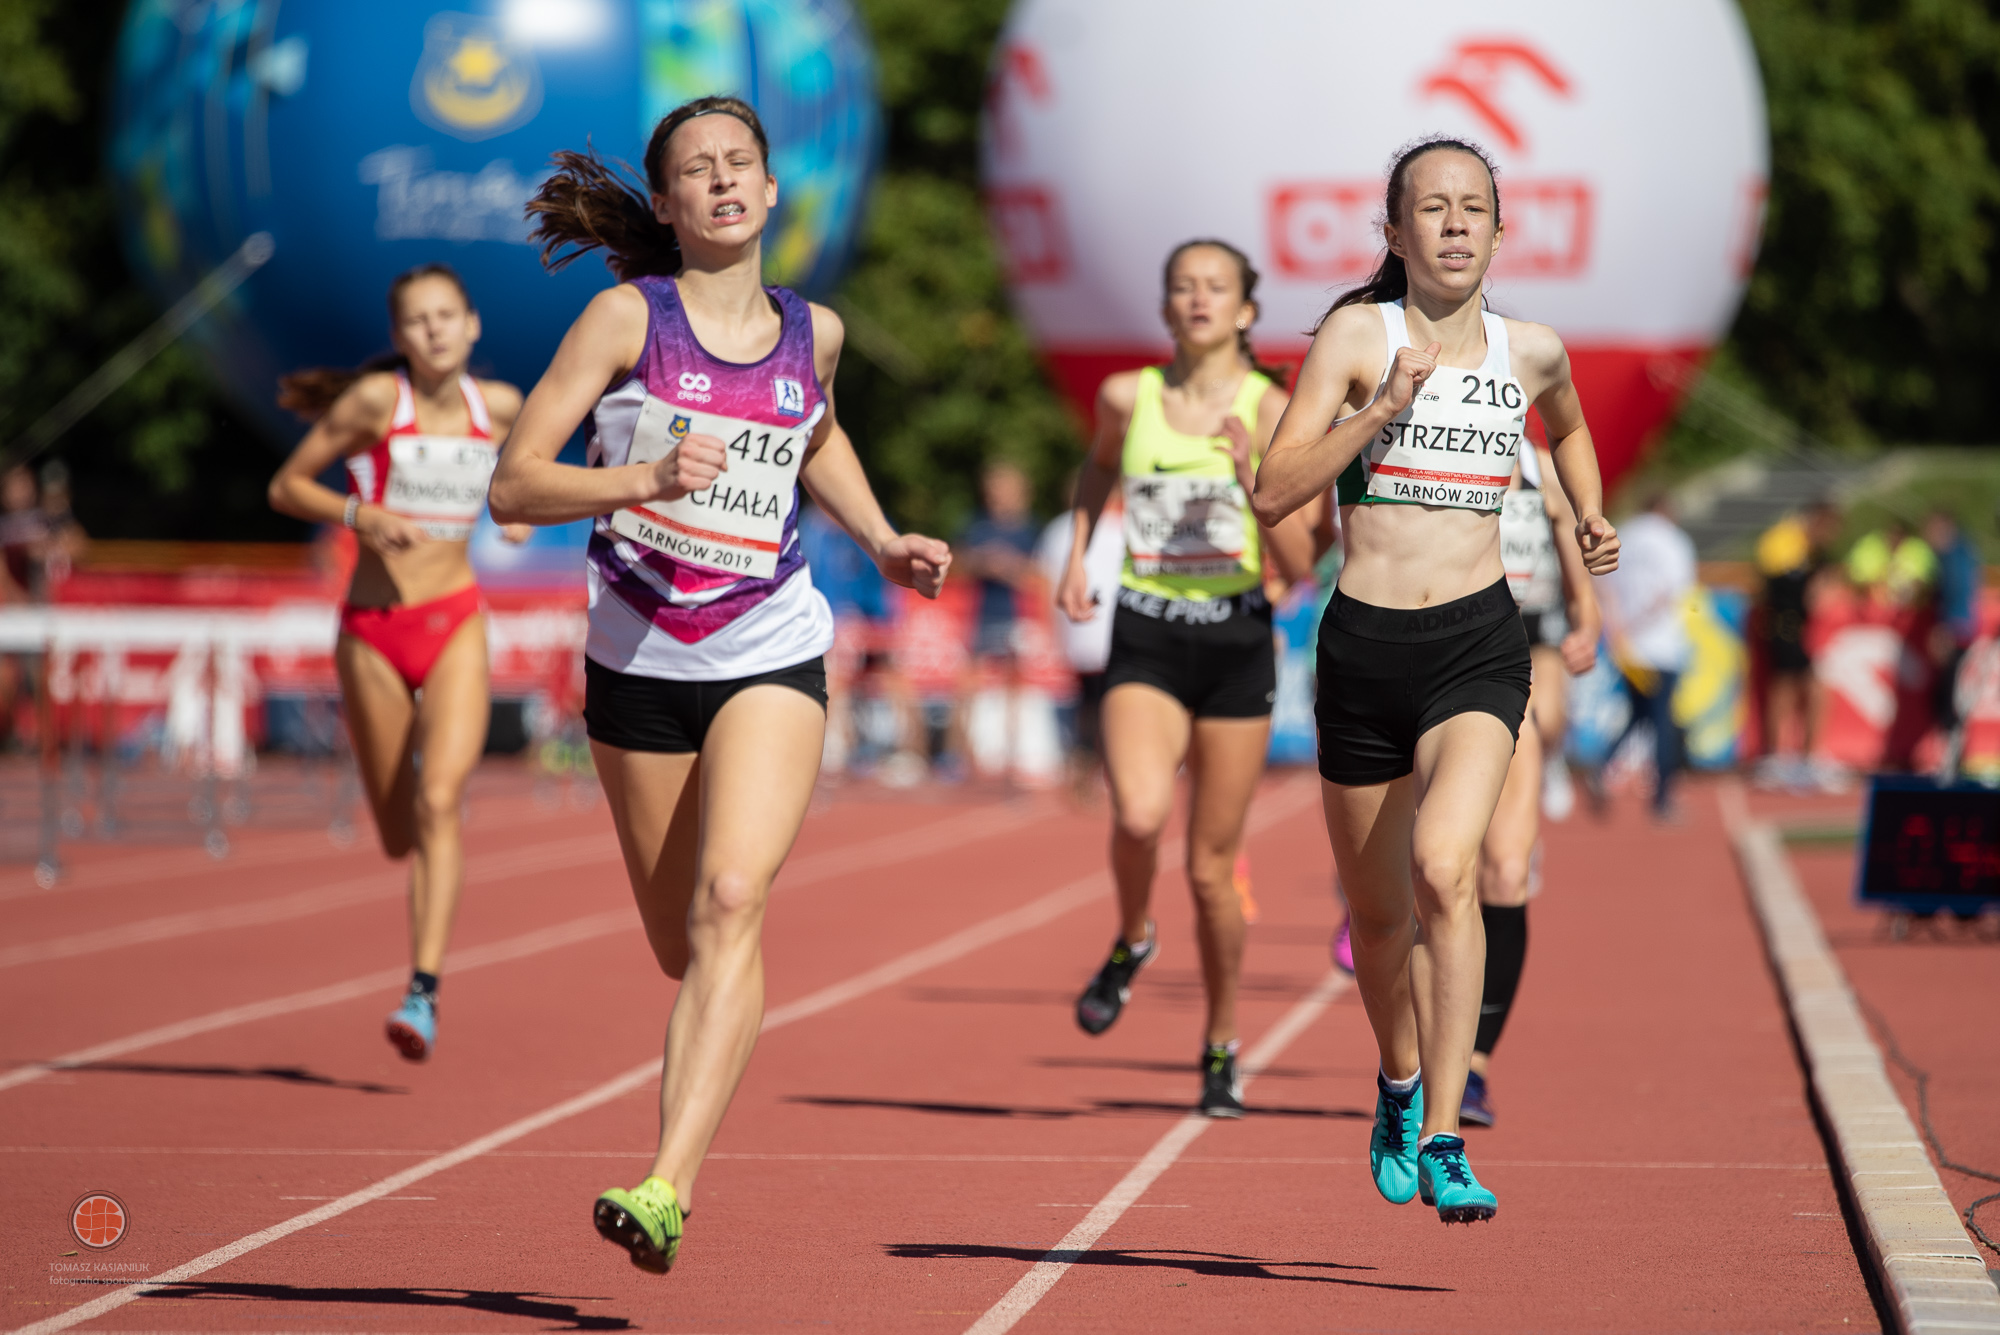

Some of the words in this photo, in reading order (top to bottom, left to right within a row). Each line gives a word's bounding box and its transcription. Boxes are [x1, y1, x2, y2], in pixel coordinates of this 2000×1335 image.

[676, 389, 712, 404] deep
[1461, 374, 1522, 409] 210
[728, 429, 794, 467] 416
[1381, 422, 1519, 457] STRZEŻYSZ
[690, 484, 779, 520] CHAŁA
[1393, 482, 1462, 503] TARNÓW
[1465, 490, 1498, 506] 2019
[637, 523, 709, 560] TARNÓW
[712, 550, 753, 570] 2019
[1164, 597, 1233, 625] PRO
[1403, 592, 1499, 634] ADIDAS
